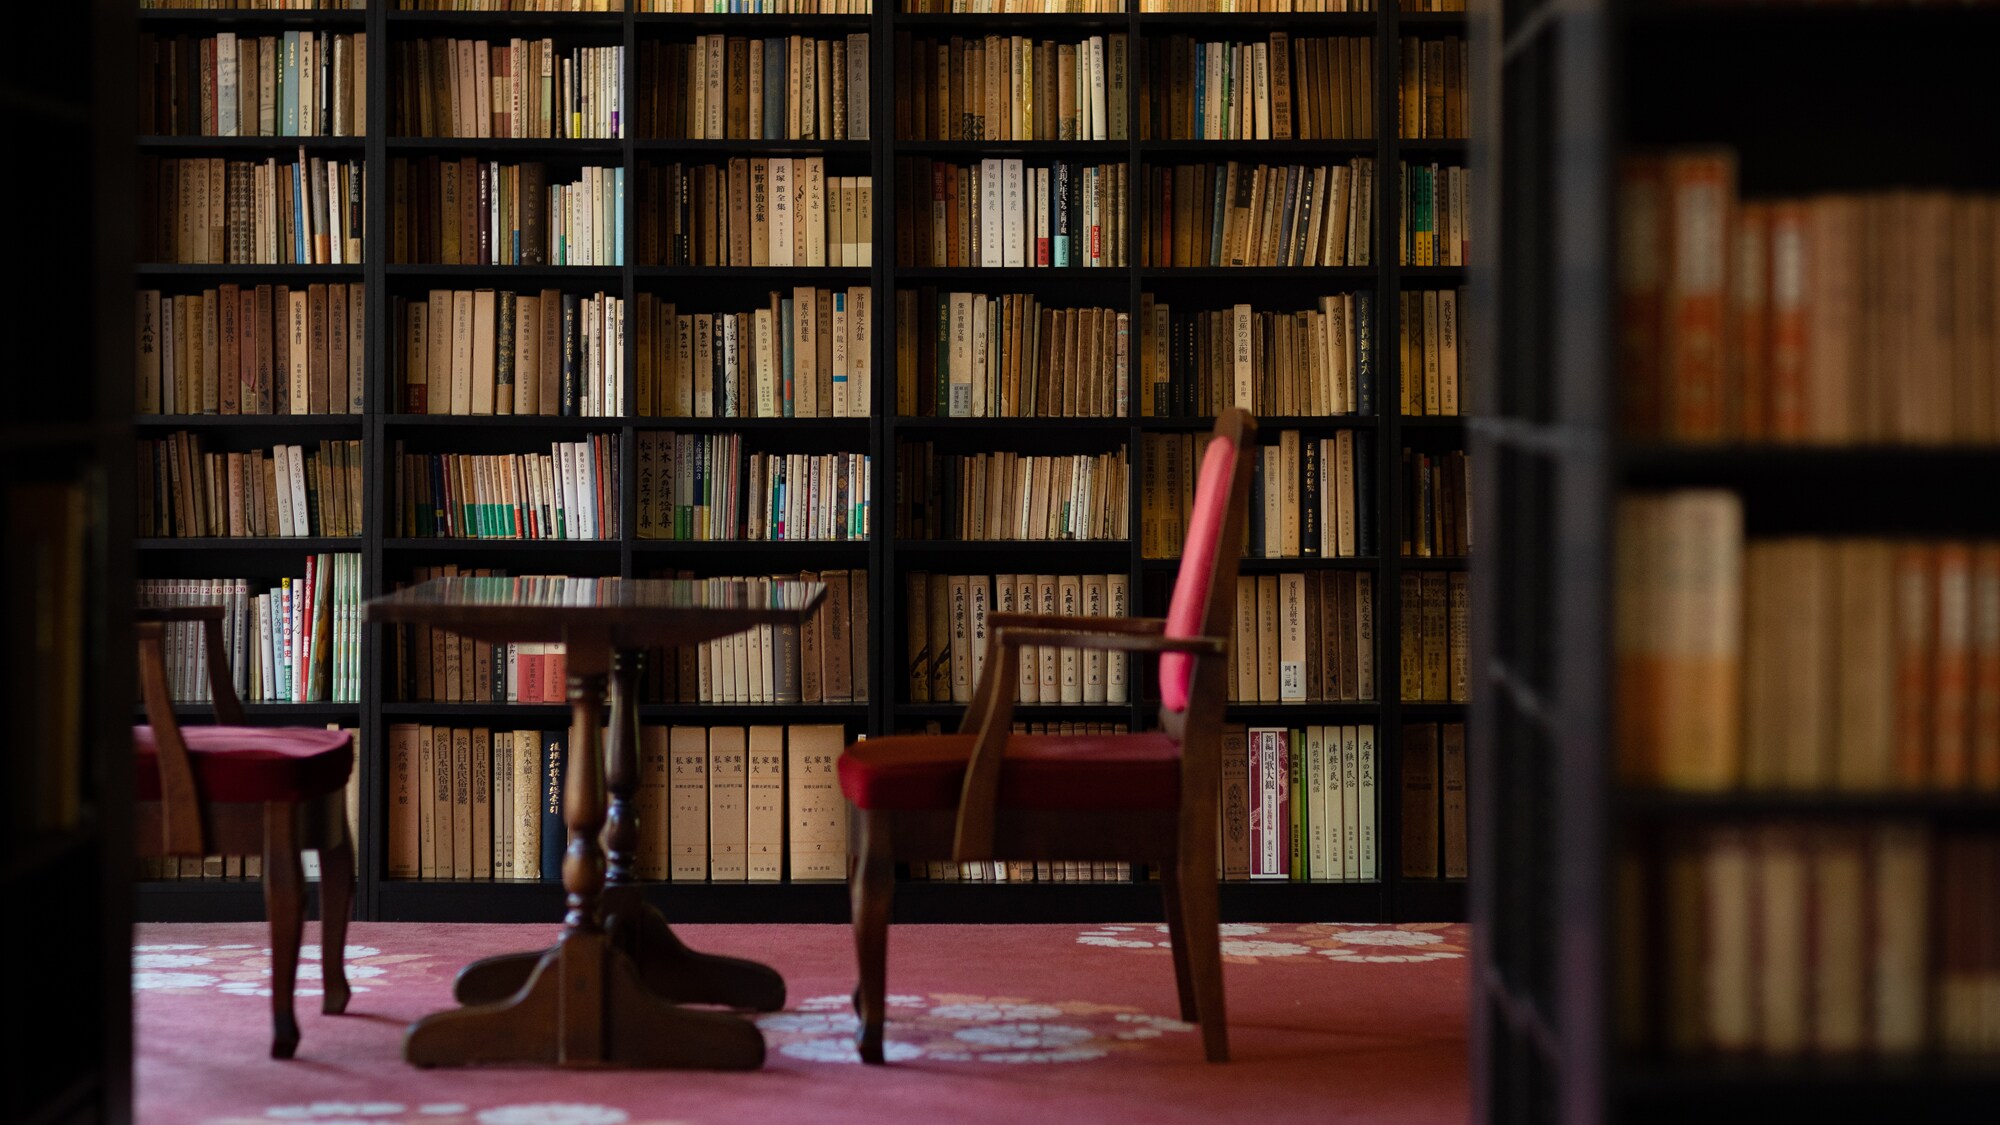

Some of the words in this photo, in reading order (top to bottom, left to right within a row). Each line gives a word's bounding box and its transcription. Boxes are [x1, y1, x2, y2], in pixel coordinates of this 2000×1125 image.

[755, 164, 765, 223] 中野重治全集
[856, 293, 865, 342] 芥川龍之介集
[1265, 735, 1275, 790] 新編国歌大観
